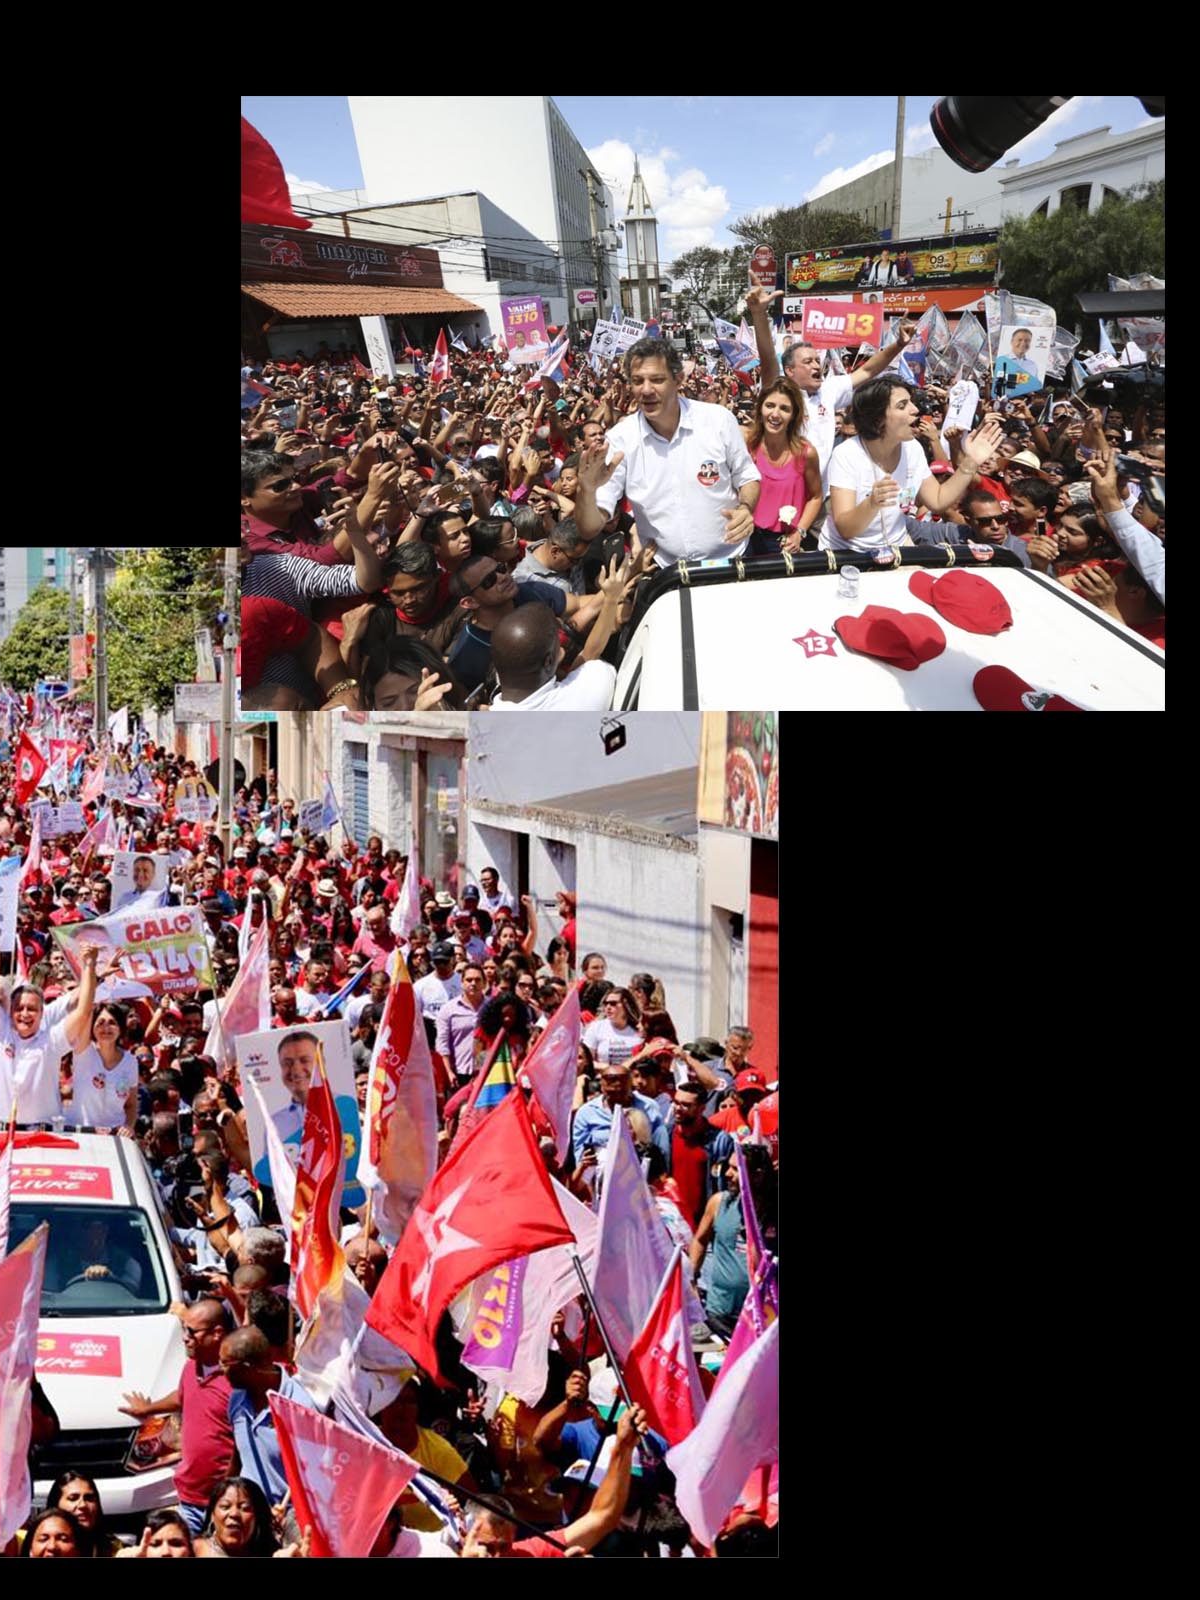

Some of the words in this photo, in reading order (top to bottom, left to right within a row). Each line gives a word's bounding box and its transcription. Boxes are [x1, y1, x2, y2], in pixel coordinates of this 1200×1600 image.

[317, 241, 388, 265] MASTER
[508, 311, 539, 325] 1310
[803, 636, 829, 652] 13
[125, 914, 192, 943] GALO
[9, 1180, 81, 1191] LIVRE
